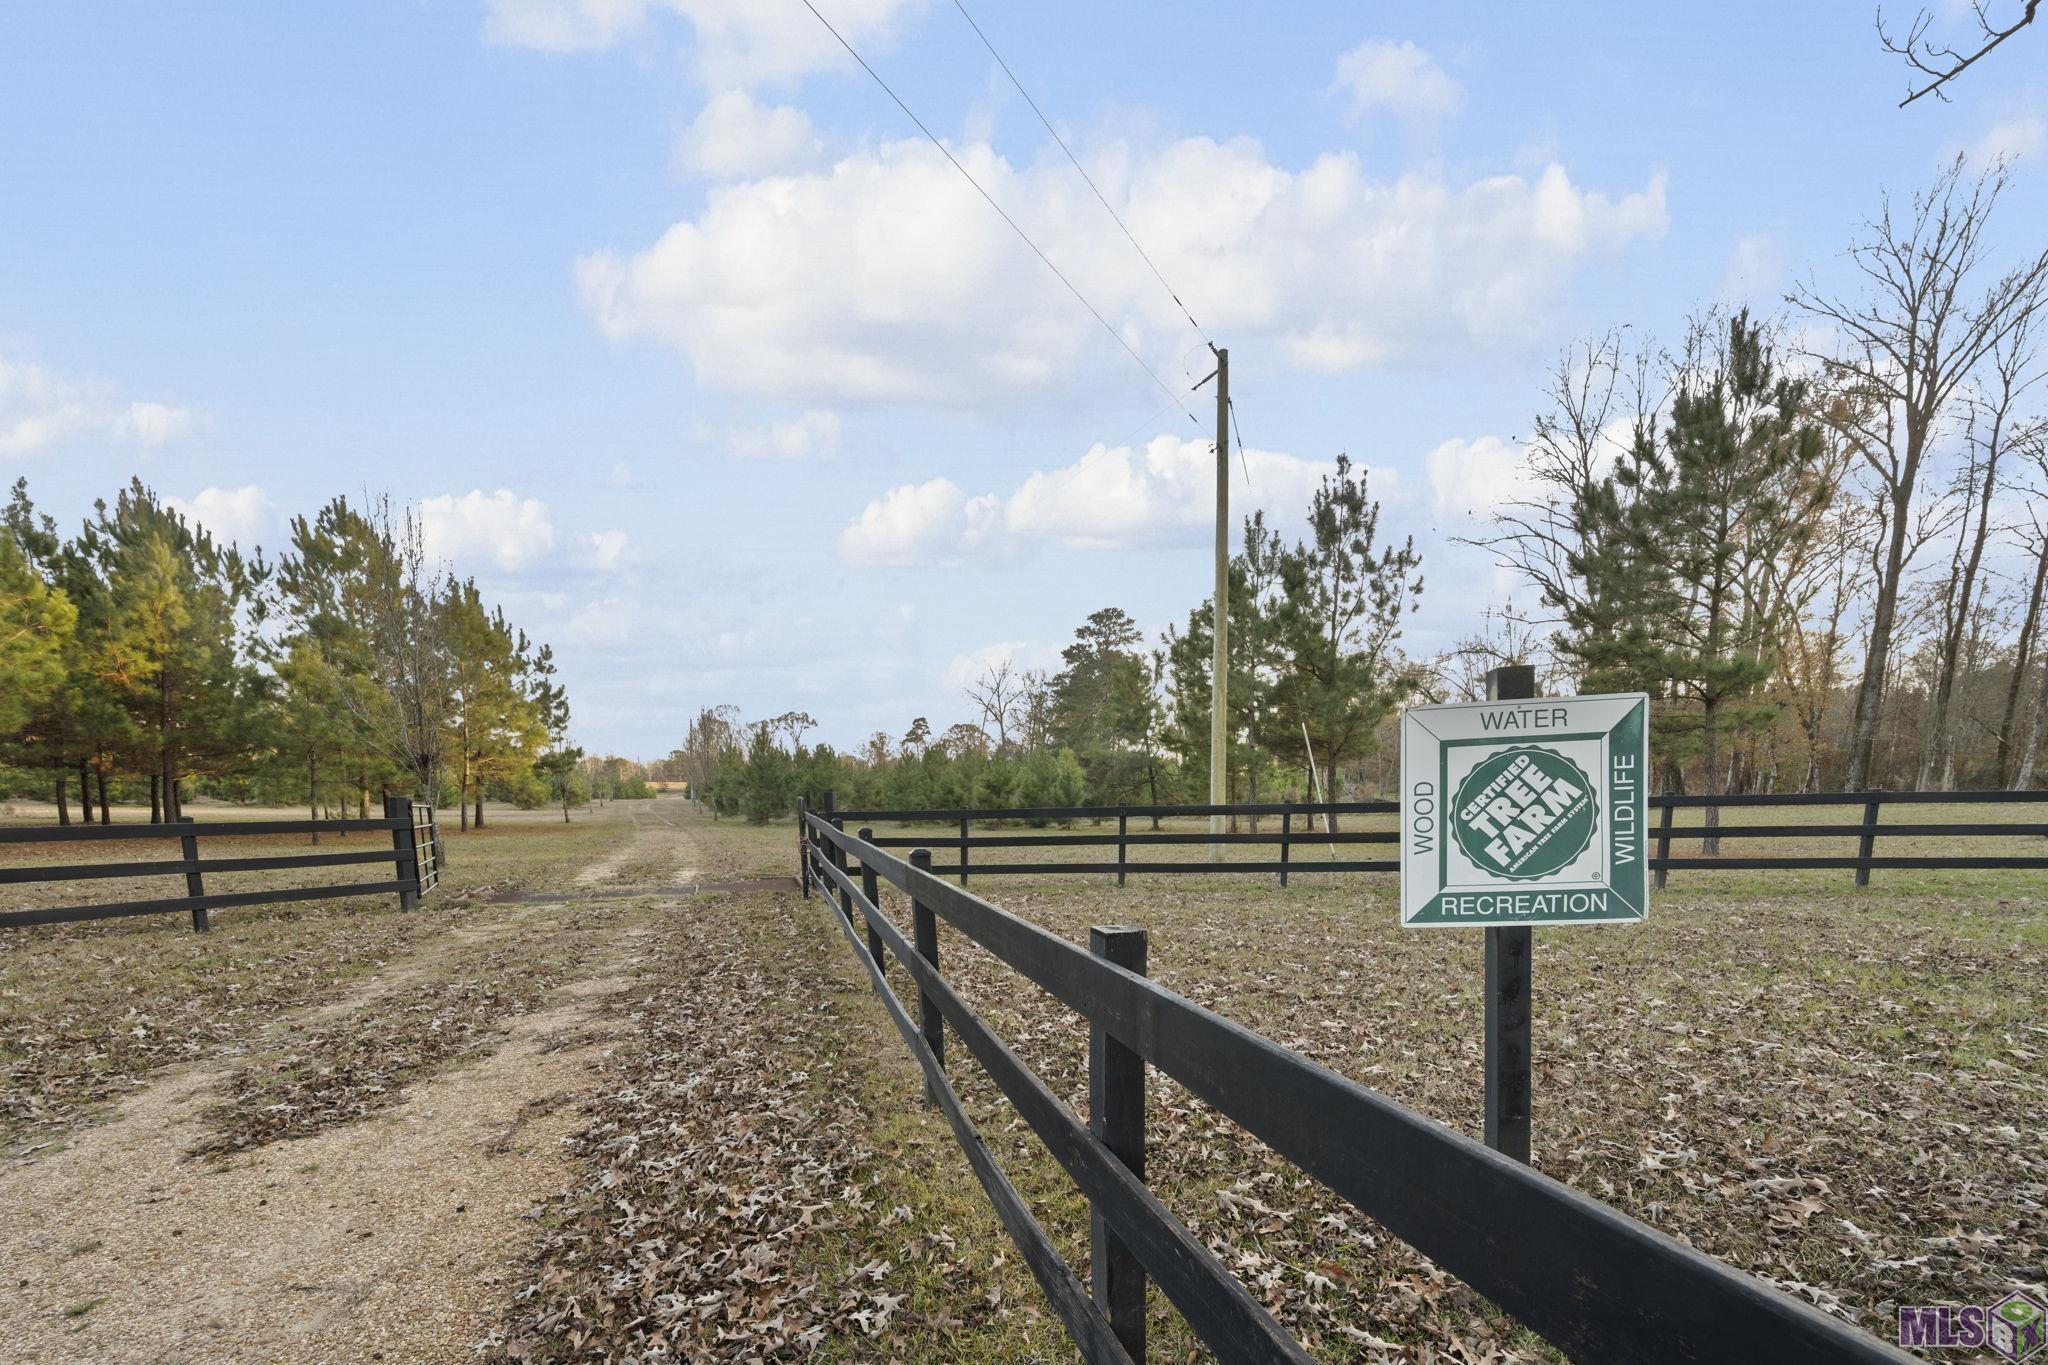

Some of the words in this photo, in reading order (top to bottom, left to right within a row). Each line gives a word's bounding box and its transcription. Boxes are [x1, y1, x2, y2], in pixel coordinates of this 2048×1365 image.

[1480, 708, 1568, 730] WATER
[1413, 782, 1434, 855] WOOD
[1461, 755, 1529, 821] CERTIFIED
[1468, 763, 1553, 839] TREE
[1483, 777, 1583, 867] FARM
[1614, 754, 1635, 865] WILDLIFE
[1509, 845, 1539, 873] AMERICAN
[1537, 832, 1552, 846] TREE
[1551, 817, 1568, 834] FARM
[1567, 797, 1589, 819] SYSTEM
[1441, 893, 1608, 915] RECREATION
